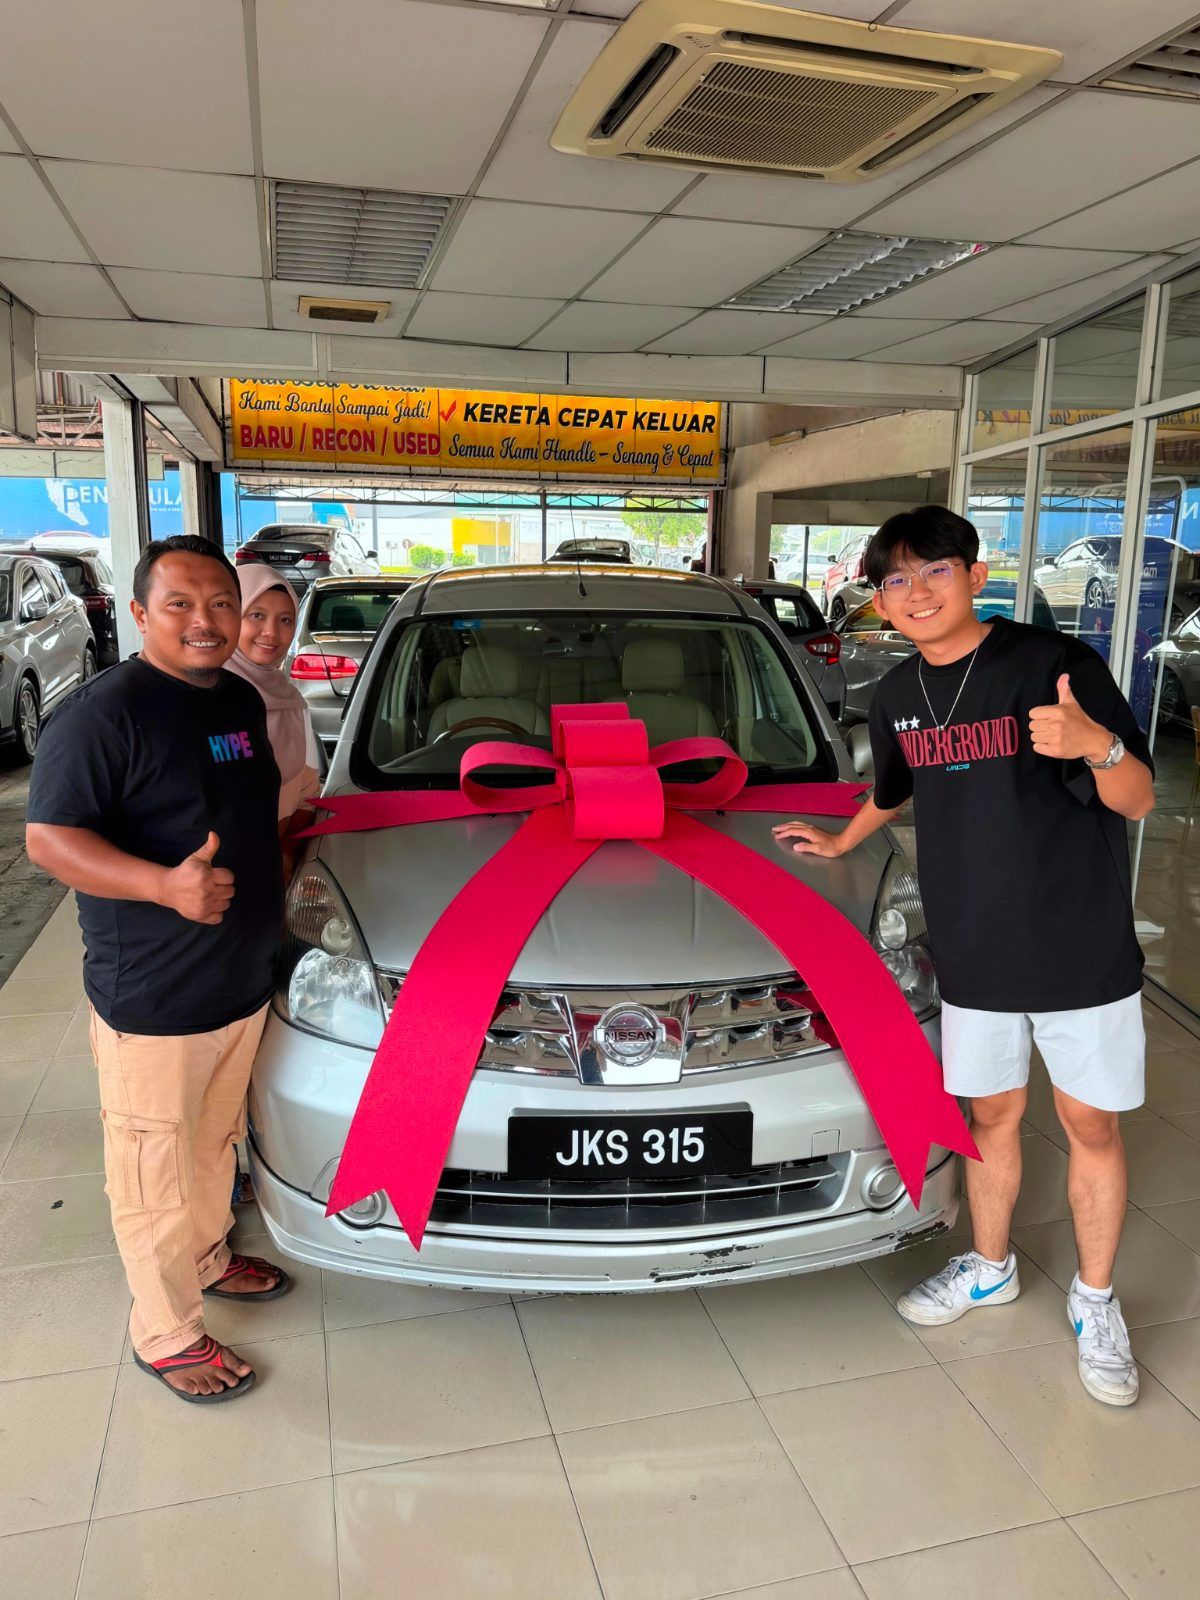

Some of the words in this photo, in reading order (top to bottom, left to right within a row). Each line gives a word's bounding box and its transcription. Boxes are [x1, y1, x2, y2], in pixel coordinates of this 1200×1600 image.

[239, 391, 282, 411] Kami
[285, 392, 333, 415] Bantu
[336, 395, 390, 421] Sampai
[393, 400, 431, 424] Jadi!
[464, 402, 550, 426] KERETA
[557, 407, 627, 430] CEPAT
[632, 411, 717, 434] KELUAR
[240, 424, 294, 449] BARU
[312, 428, 376, 453] RECON
[393, 434, 441, 456] USED
[449, 433, 495, 458] Semua
[500, 436, 539, 460] Kami
[543, 439, 596, 463] Handle
[612, 441, 659, 474] Senang
[662, 443, 674, 466] &
[679, 444, 714, 474] Cepat
[207, 731, 254, 763] HYPE
[604, 1030, 656, 1041] NISSAN
[556, 1129, 629, 1166] JKS
[642, 1126, 704, 1165] 315
